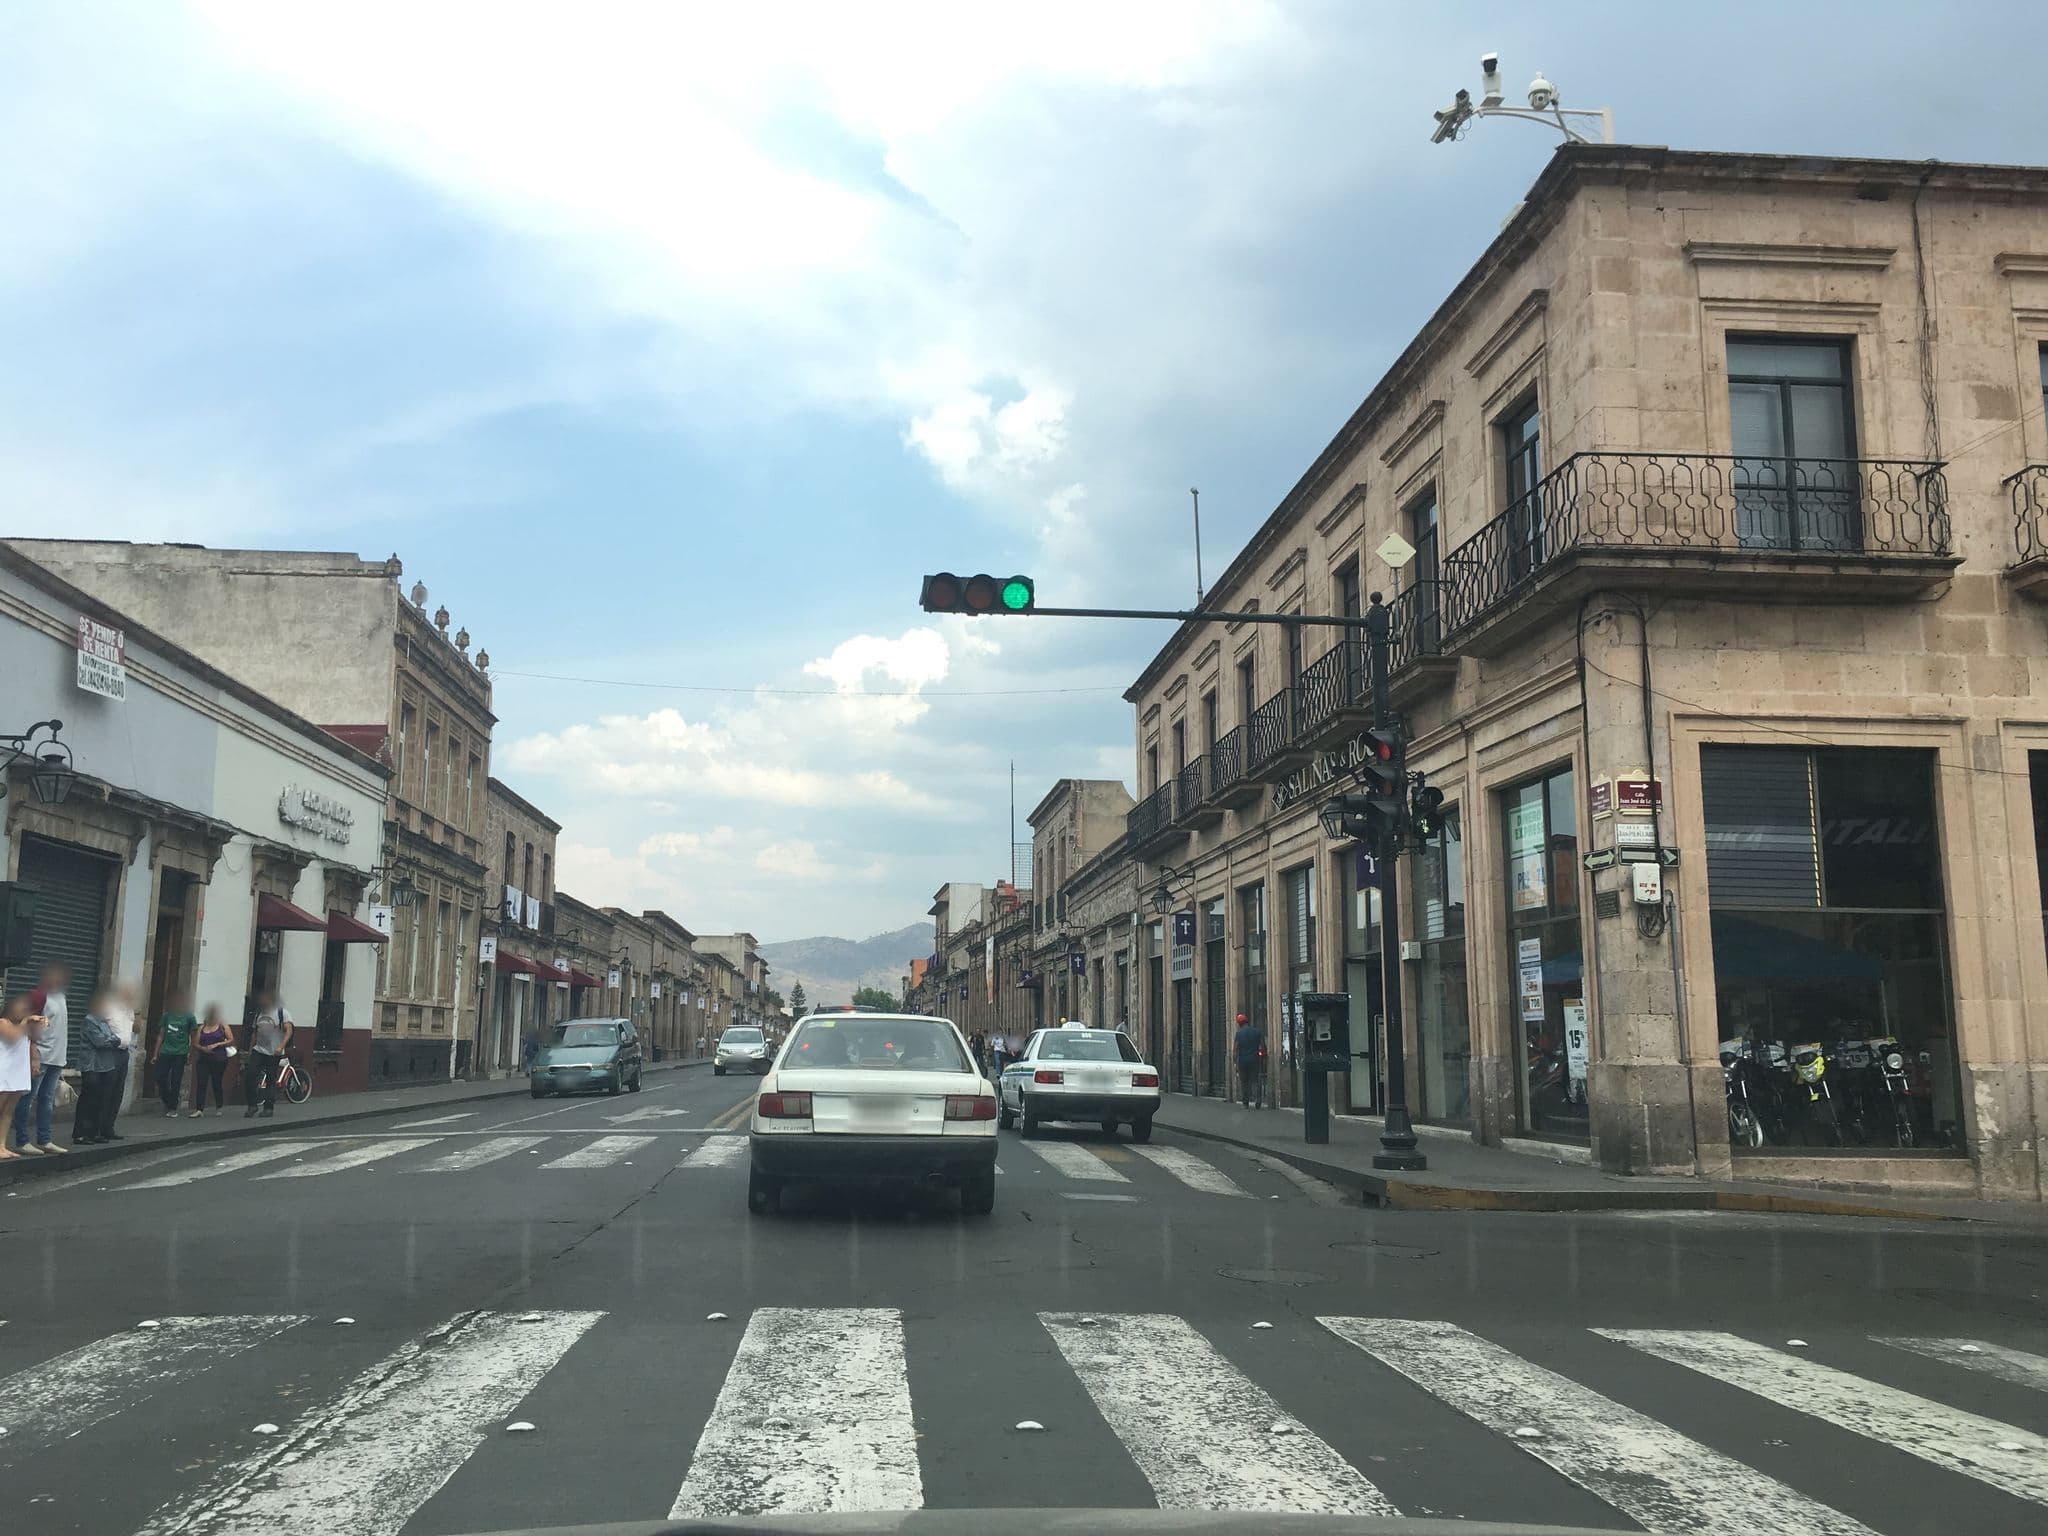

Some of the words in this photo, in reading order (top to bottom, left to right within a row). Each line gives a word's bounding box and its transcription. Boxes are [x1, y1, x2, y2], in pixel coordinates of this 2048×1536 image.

[80, 616, 90, 636] SE
[91, 621, 116, 646] VENDE
[83, 635, 94, 653] SE
[95, 640, 119, 663] RENTA
